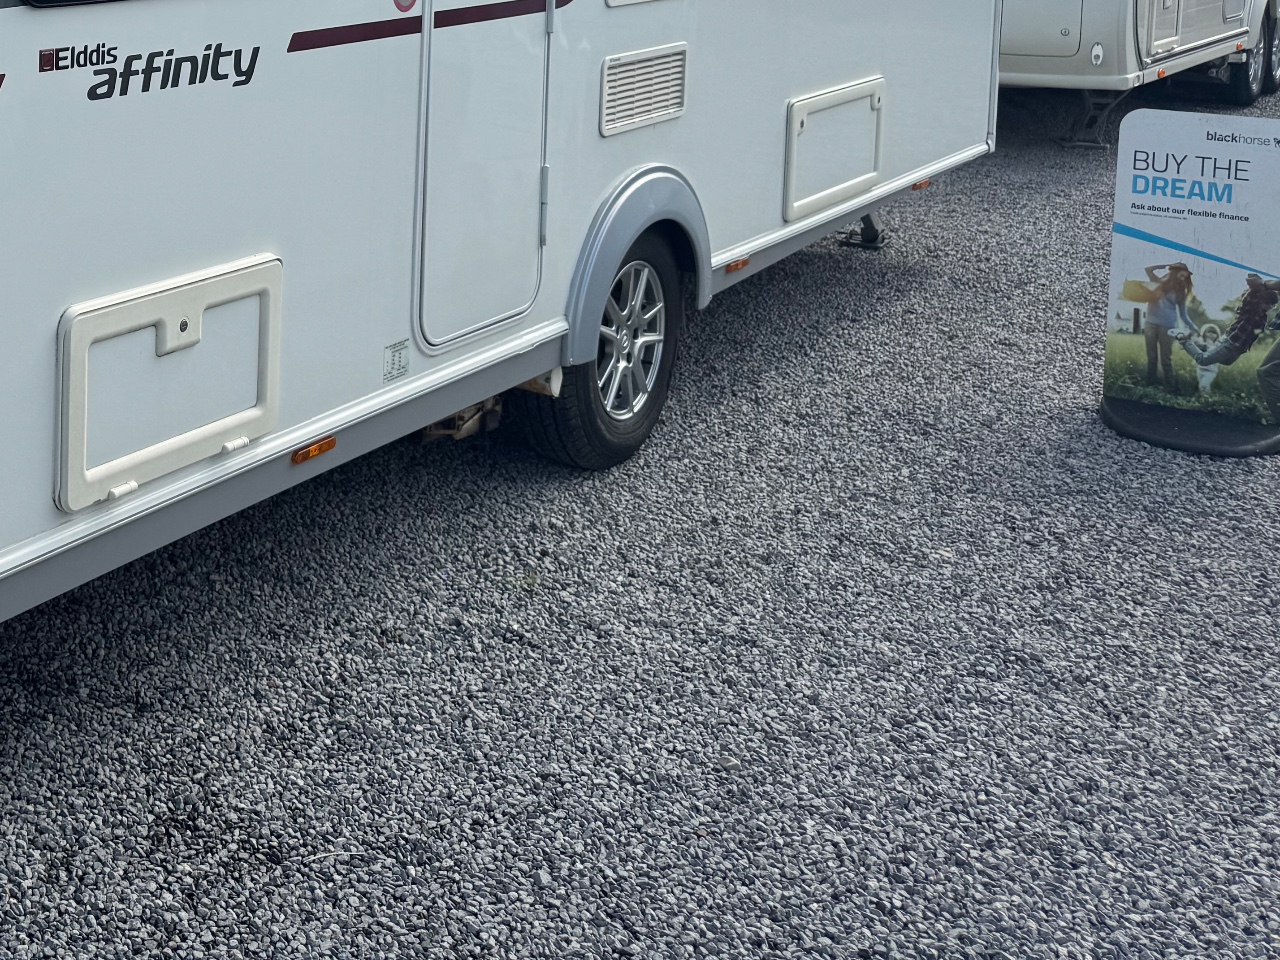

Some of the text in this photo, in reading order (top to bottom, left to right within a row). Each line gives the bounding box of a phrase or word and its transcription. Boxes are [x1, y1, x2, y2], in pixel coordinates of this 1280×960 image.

[55, 43, 118, 71] Elddis
[87, 43, 261, 101] affinity
[1206, 131, 1271, 146] blackhorse
[1133, 150, 1251, 181] BUY THE
[1131, 174, 1233, 204] DREAM
[1131, 202, 1146, 211] Ask
[1147, 205, 1170, 213] about
[1187, 208, 1217, 219] flexible
[1219, 212, 1250, 222] finance
